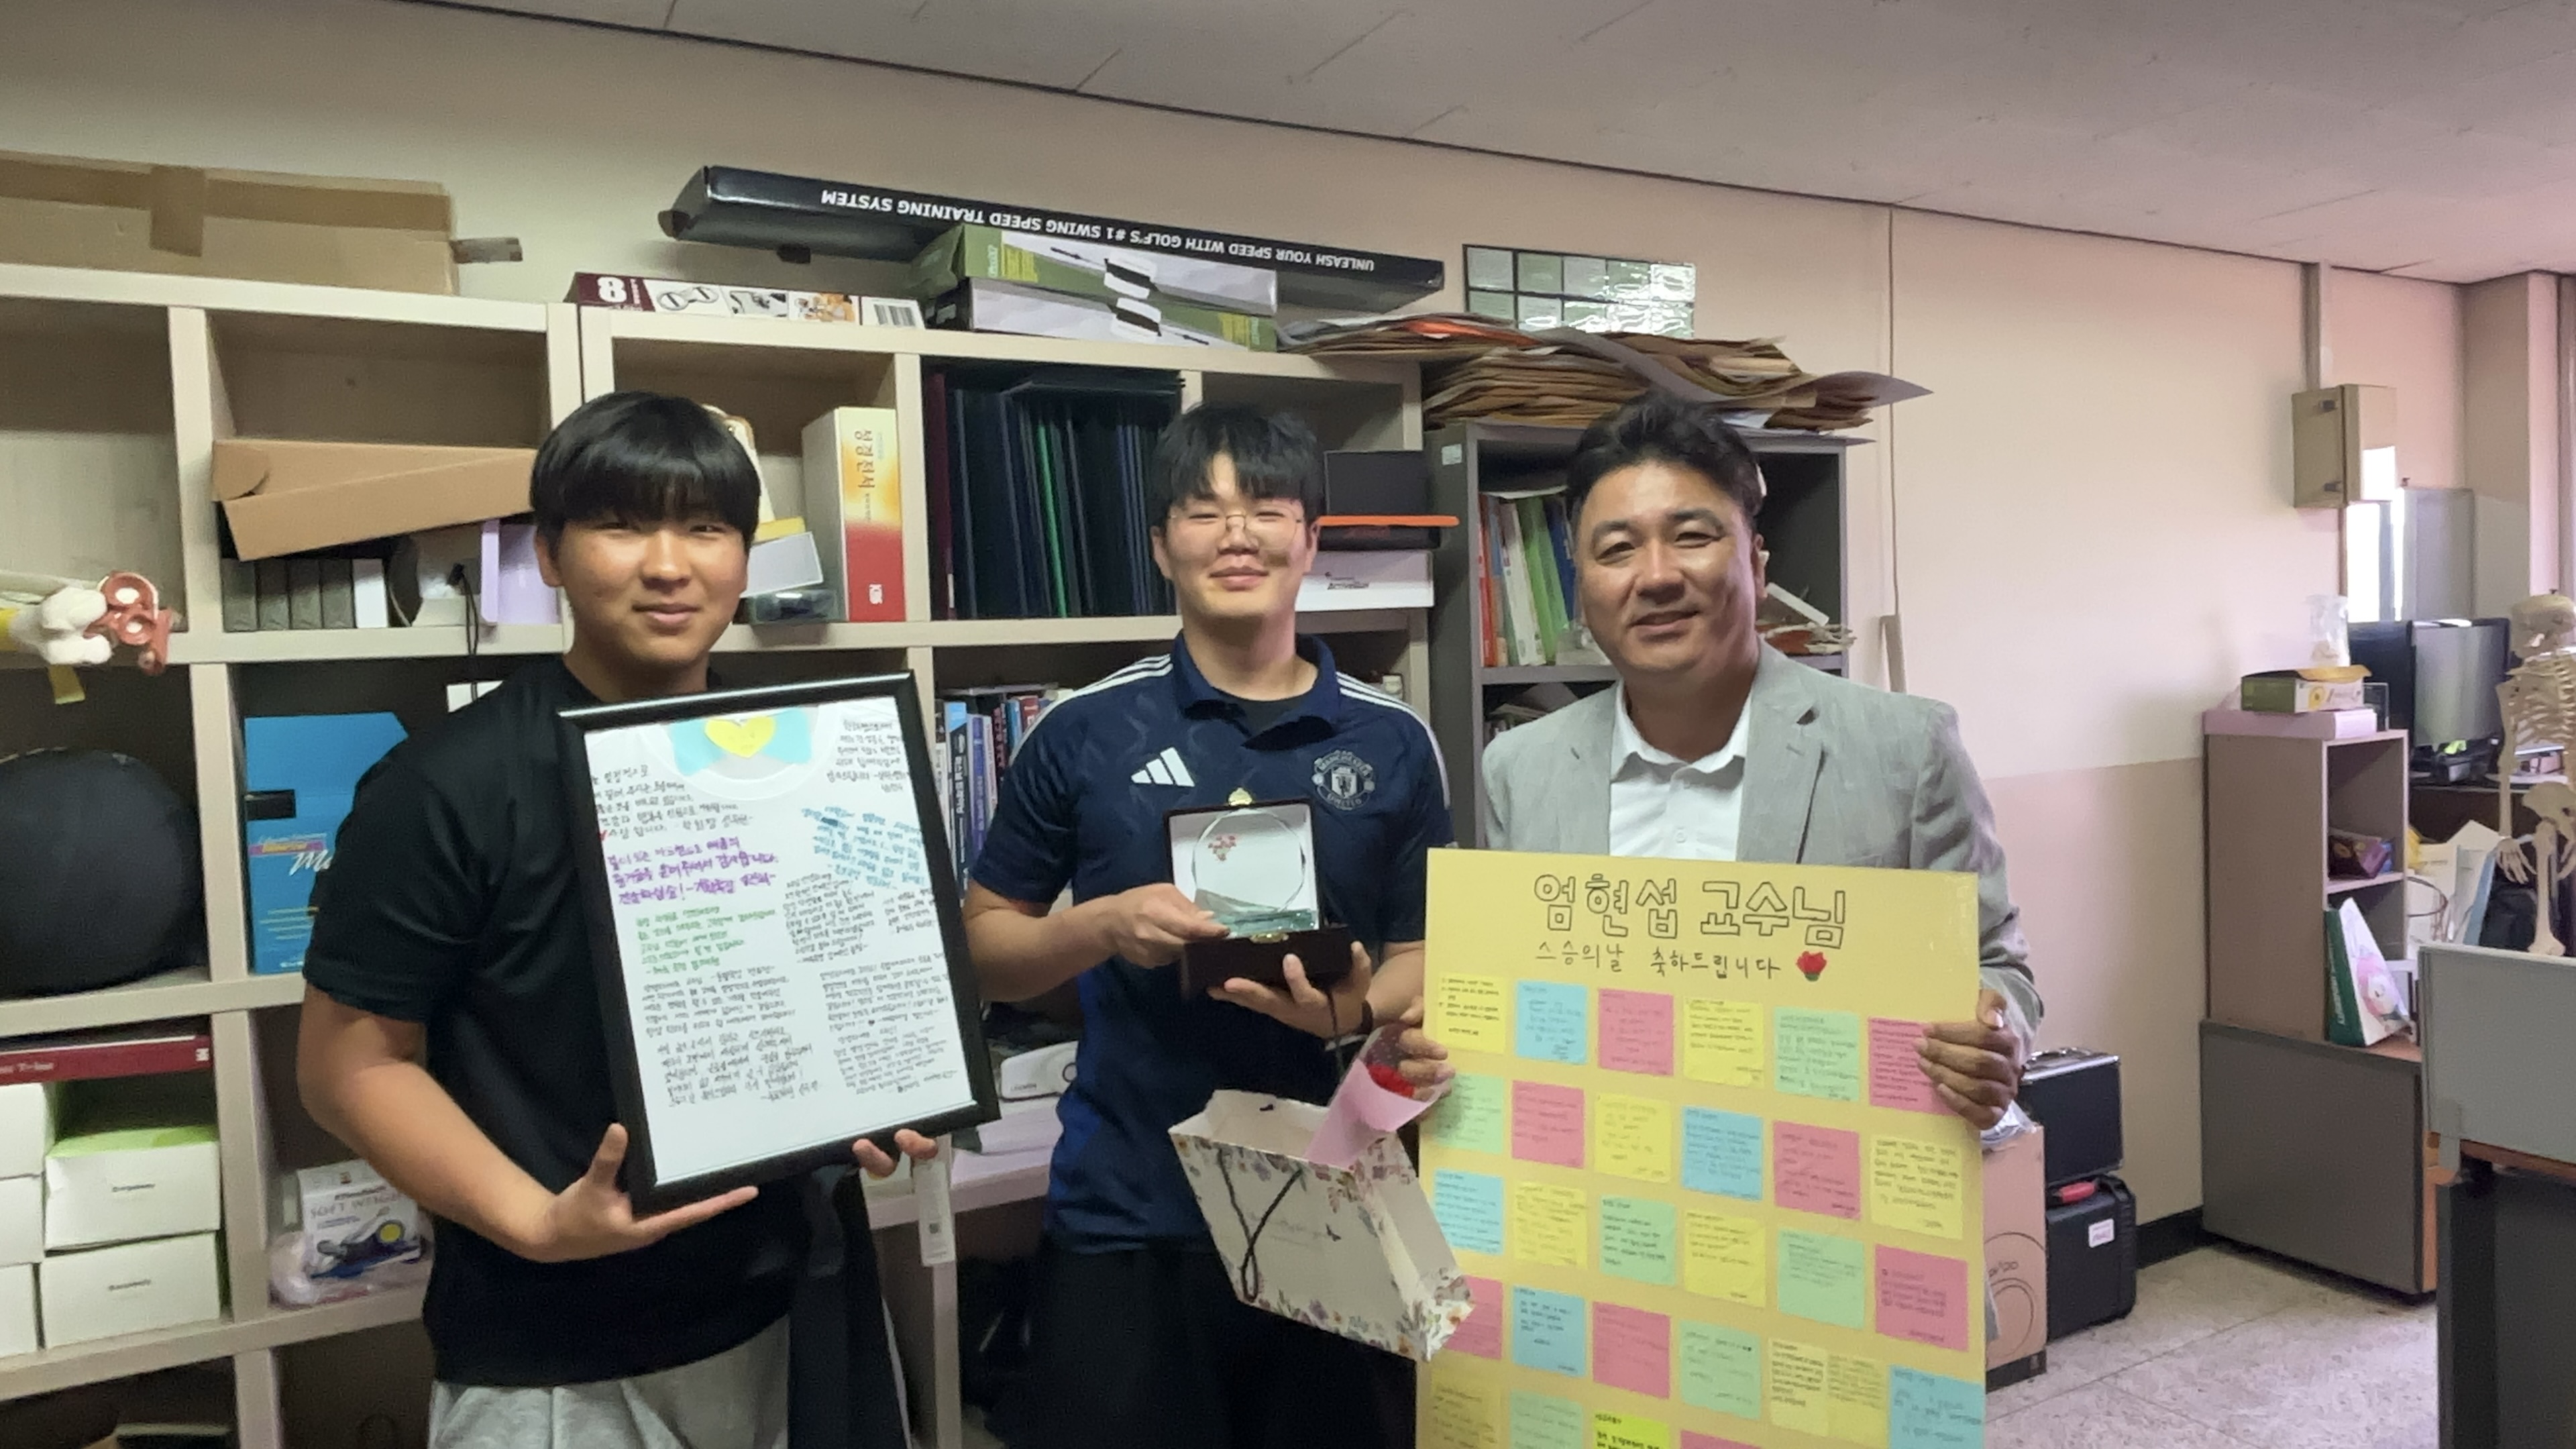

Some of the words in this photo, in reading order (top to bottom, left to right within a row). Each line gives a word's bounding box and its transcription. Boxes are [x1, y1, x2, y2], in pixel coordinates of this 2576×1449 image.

[820, 190, 893, 211] SYSTEM
[897, 200, 985, 224] TRAINING
[989, 213, 1042, 231] SPEED
[1045, 219, 1102, 238] SWING
[1106, 227, 1127, 241] #1
[1130, 230, 1182, 248] GOLF'S
[1185, 237, 1225, 254] WITH
[1228, 243, 1273, 260] SPEED
[1275, 249, 1312, 264] YOUR
[1316, 254, 1375, 271] UNLEASH
[596, 276, 628, 303] 8
[853, 429, 876, 490] 성경전서
[1534, 872, 1678, 940] 엄현섭
[1700, 880, 1846, 950] 교수님
[1650, 946, 1782, 979] 축하드립니다
